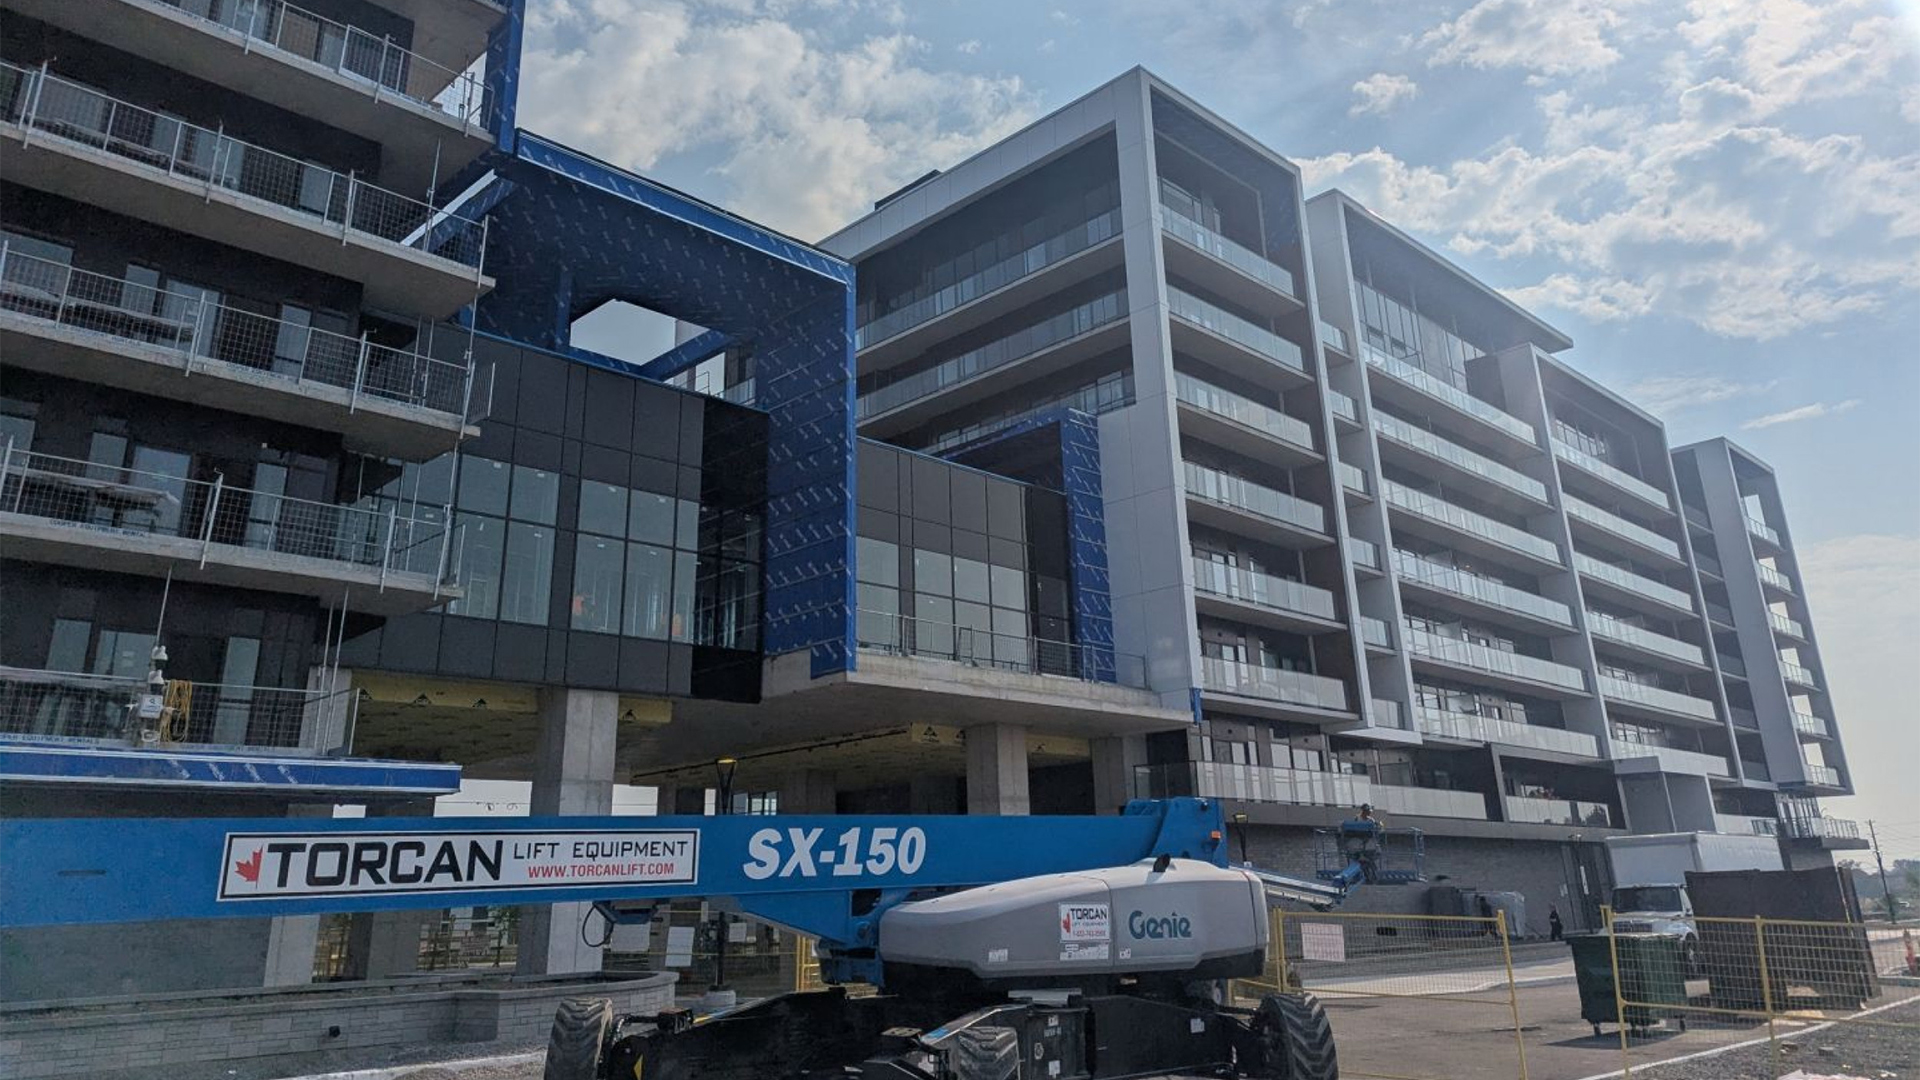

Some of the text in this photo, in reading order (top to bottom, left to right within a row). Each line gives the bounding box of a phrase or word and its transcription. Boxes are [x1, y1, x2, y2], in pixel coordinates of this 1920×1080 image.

[22, 733, 65, 745] EQUIPMENT
[68, 737, 100, 746] RENTALS
[267, 839, 689, 888] TORCAN LIFT EQUIPMENT
[742, 826, 928, 880] SX-150
[527, 862, 675, 879] WWW.TORCANLIFT.COM
[1070, 907, 1108, 920] TORCAN
[1128, 910, 1193, 940] Genie
